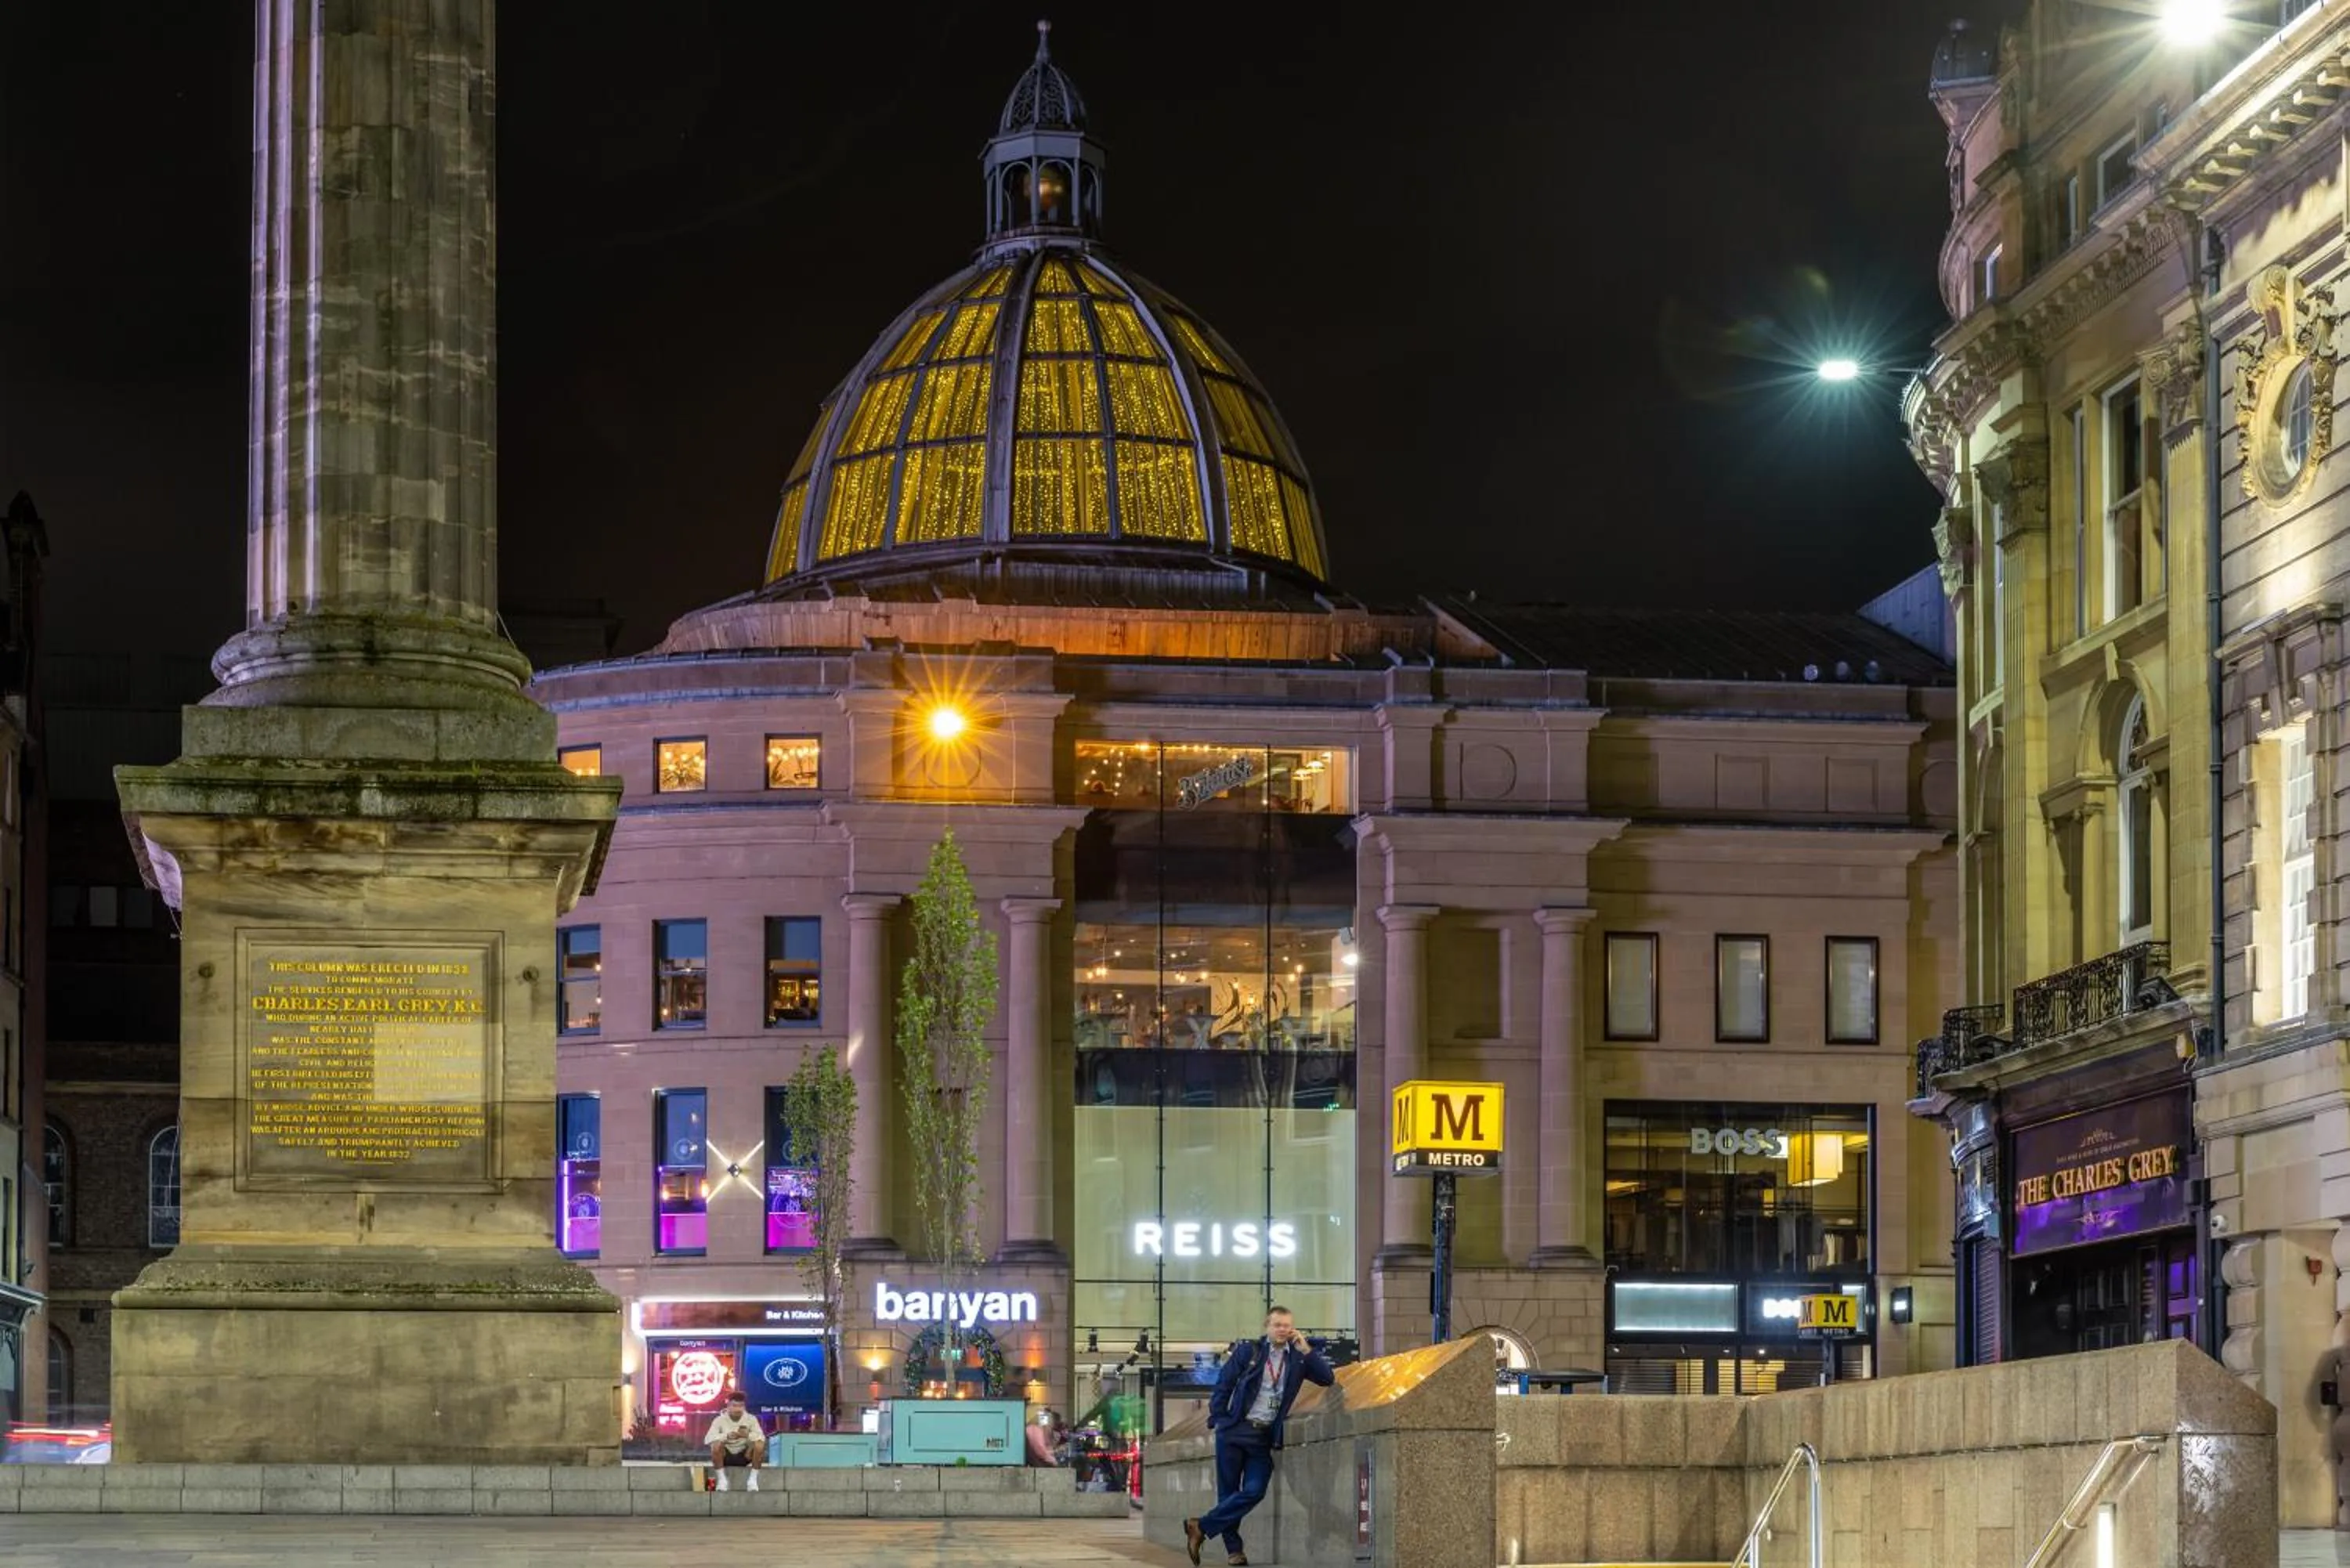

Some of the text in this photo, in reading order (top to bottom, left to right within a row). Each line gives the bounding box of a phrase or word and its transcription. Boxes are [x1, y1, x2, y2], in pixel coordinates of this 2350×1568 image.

[345, 963, 367, 973] WAS
[252, 996, 339, 1011] CHARLES
[344, 997, 395, 1012] EARL
[1430, 1093, 1484, 1140] M
[1691, 1128, 1781, 1155] BOSS
[1429, 1153, 1484, 1166] METRO
[2019, 1176, 2051, 1205] THE
[2053, 1158, 2124, 1198] CHARLES
[2128, 1145, 2178, 1183] GREY
[1135, 1222, 1296, 1256] REISS
[766, 1310, 782, 1320] Bar
[877, 1282, 1037, 1328] banyan
[1824, 1300, 1848, 1322] M
